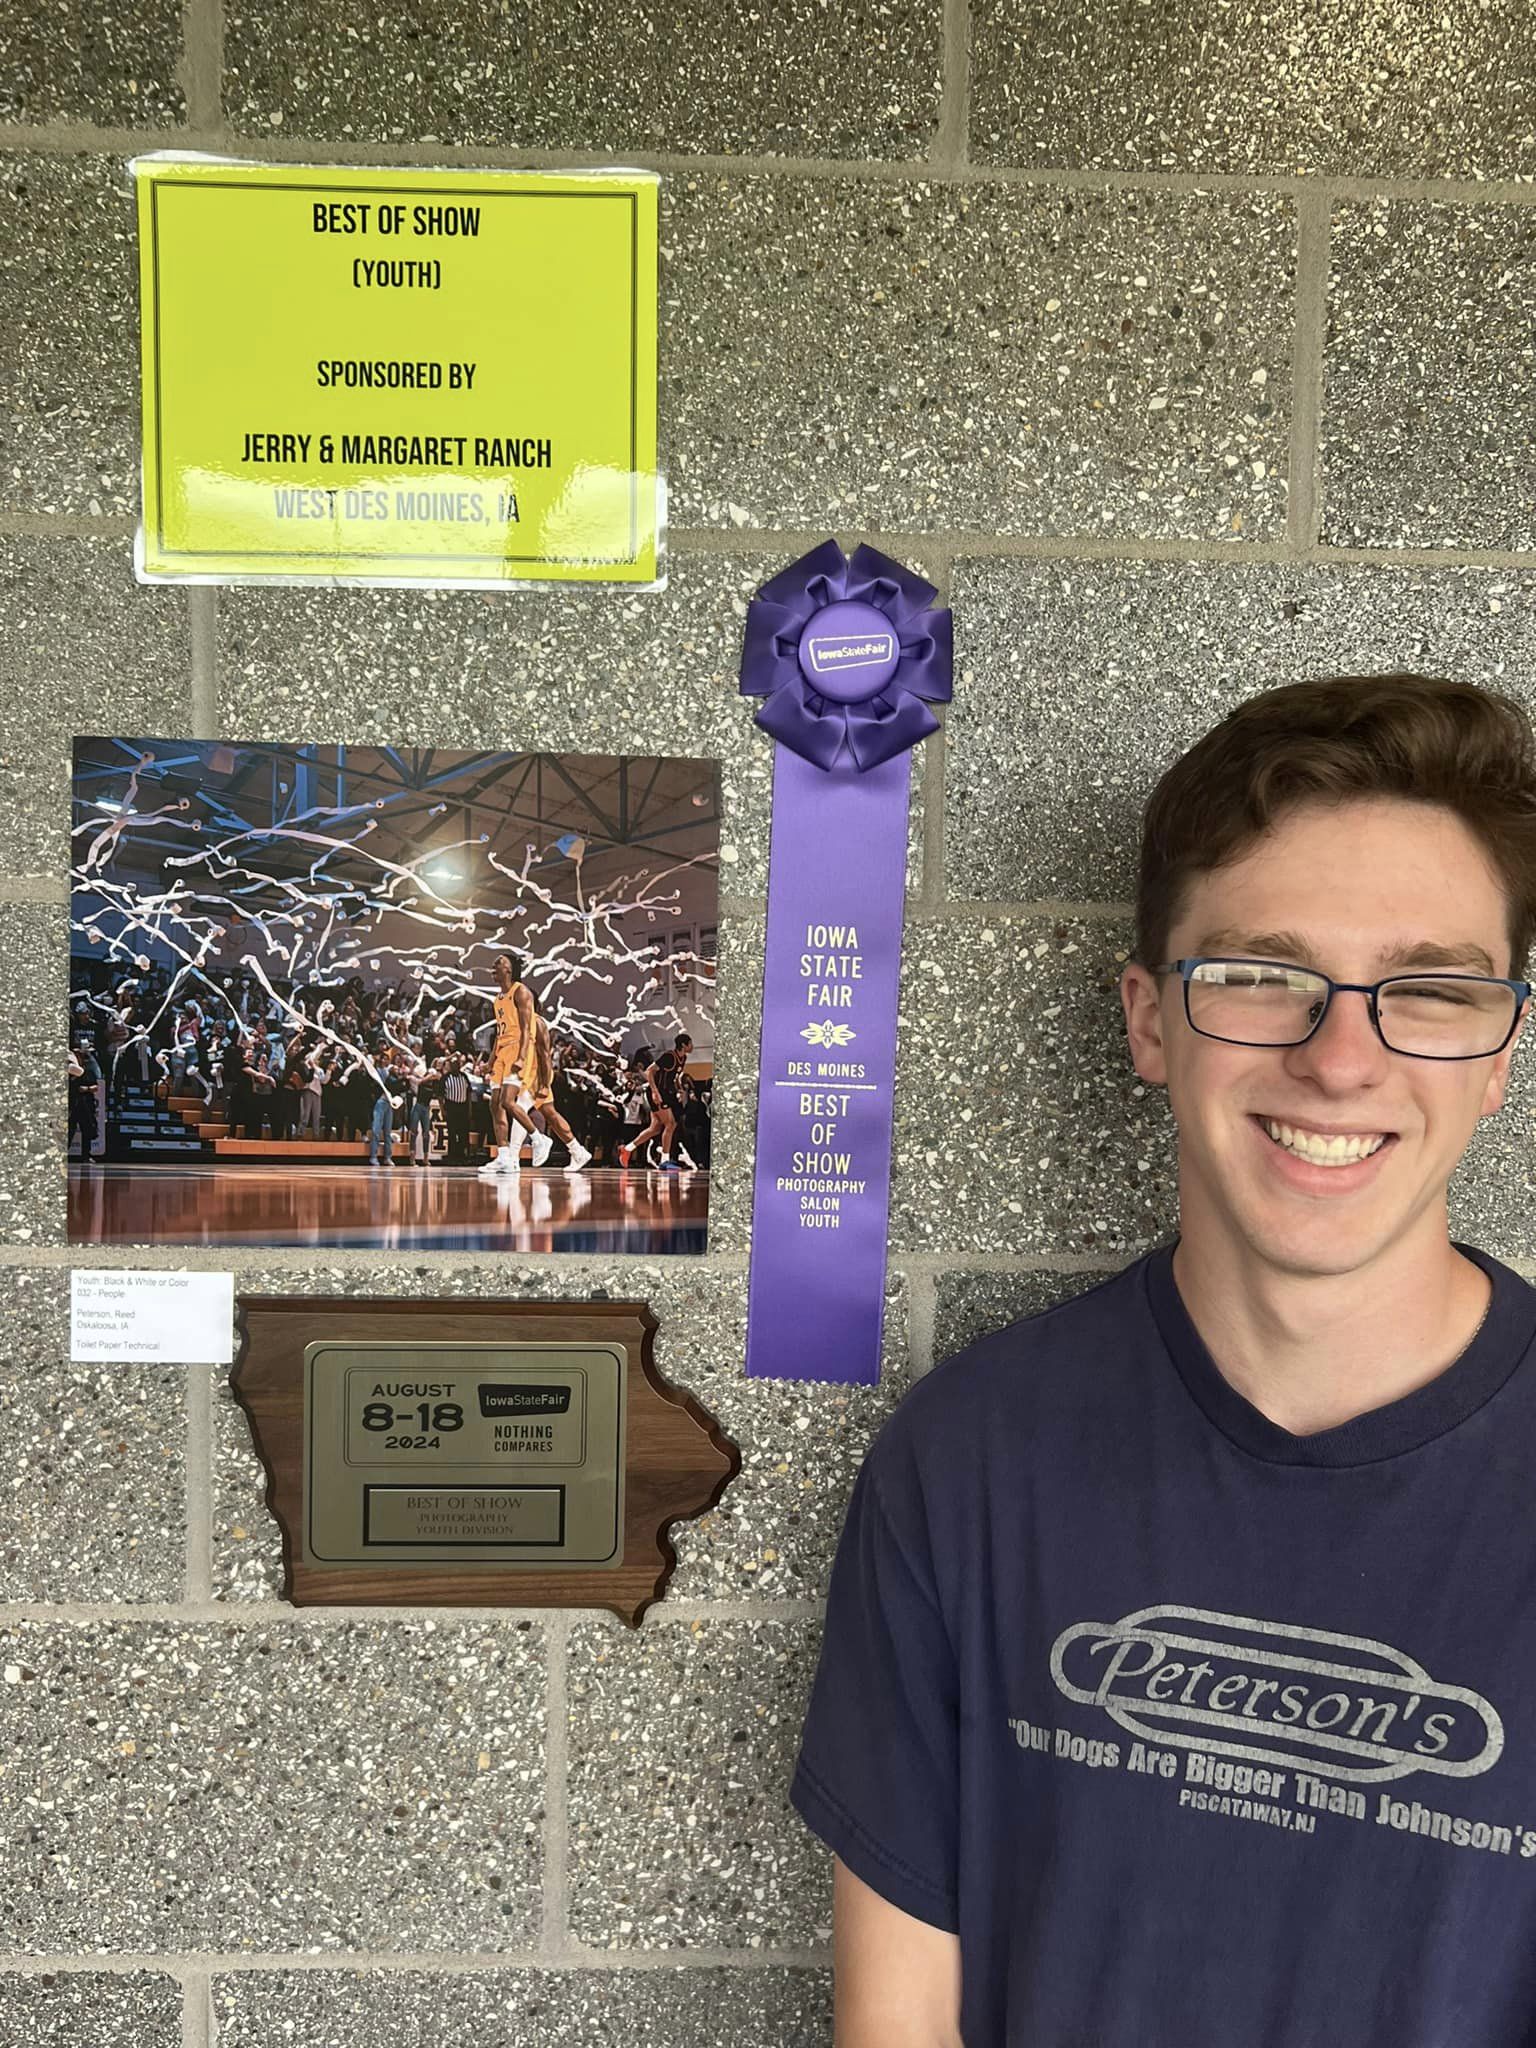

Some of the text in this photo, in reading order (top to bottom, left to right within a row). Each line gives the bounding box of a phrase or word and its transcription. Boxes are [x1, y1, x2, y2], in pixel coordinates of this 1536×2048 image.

[312, 203, 481, 236] BEST OF SHOW
[352, 258, 441, 290] (YOUTH)
[316, 360, 476, 390] SPONSORED BY
[241, 433, 552, 468] JERRY & MARGARET RANCH
[274, 489, 520, 527] WEST DES MOINES, IA
[806, 925, 858, 949] IOWA
[800, 954, 863, 979] STATE
[807, 984, 852, 1007] FAIR
[788, 1062, 865, 1078] DES MOINES
[799, 1095, 850, 1117] BEST
[811, 1123, 836, 1145] OF
[792, 1153, 851, 1175] SHOW
[776, 1178, 866, 1194] PHOTOGRAPHY
[800, 1196, 840, 1211] SALON
[799, 1214, 840, 1229] YOUTH
[104, 1277, 125, 1286] Black
[127, 1277, 133, 1286] &
[136, 1278, 157, 1287] White
[169, 1279, 189, 1287] Color
[99, 1289, 125, 1299] People
[115, 1310, 136, 1319] Reed
[77, 1340, 160, 1352] Toilet Paper Technical
[371, 1384, 456, 1397] AUGUST
[485, 1394, 566, 1407] IowaStateFair
[362, 1403, 464, 1432] 8-18
[494, 1425, 553, 1439] NOTHING
[385, 1436, 441, 1449] 2024
[494, 1441, 553, 1452] COMPARES
[407, 1497, 522, 1509] BEST OF SHOW
[419, 1513, 508, 1523] PHOTOGRAPHY
[416, 1526, 513, 1535] YOUTH DIVISION
[1089, 1634, 1456, 1756] Peterson's
[1055, 1728, 1119, 1768] Dogs
[1127, 1743, 1177, 1778] Are
[1185, 1753, 1286, 1799] Bigger
[1294, 1773, 1365, 1820] Than
